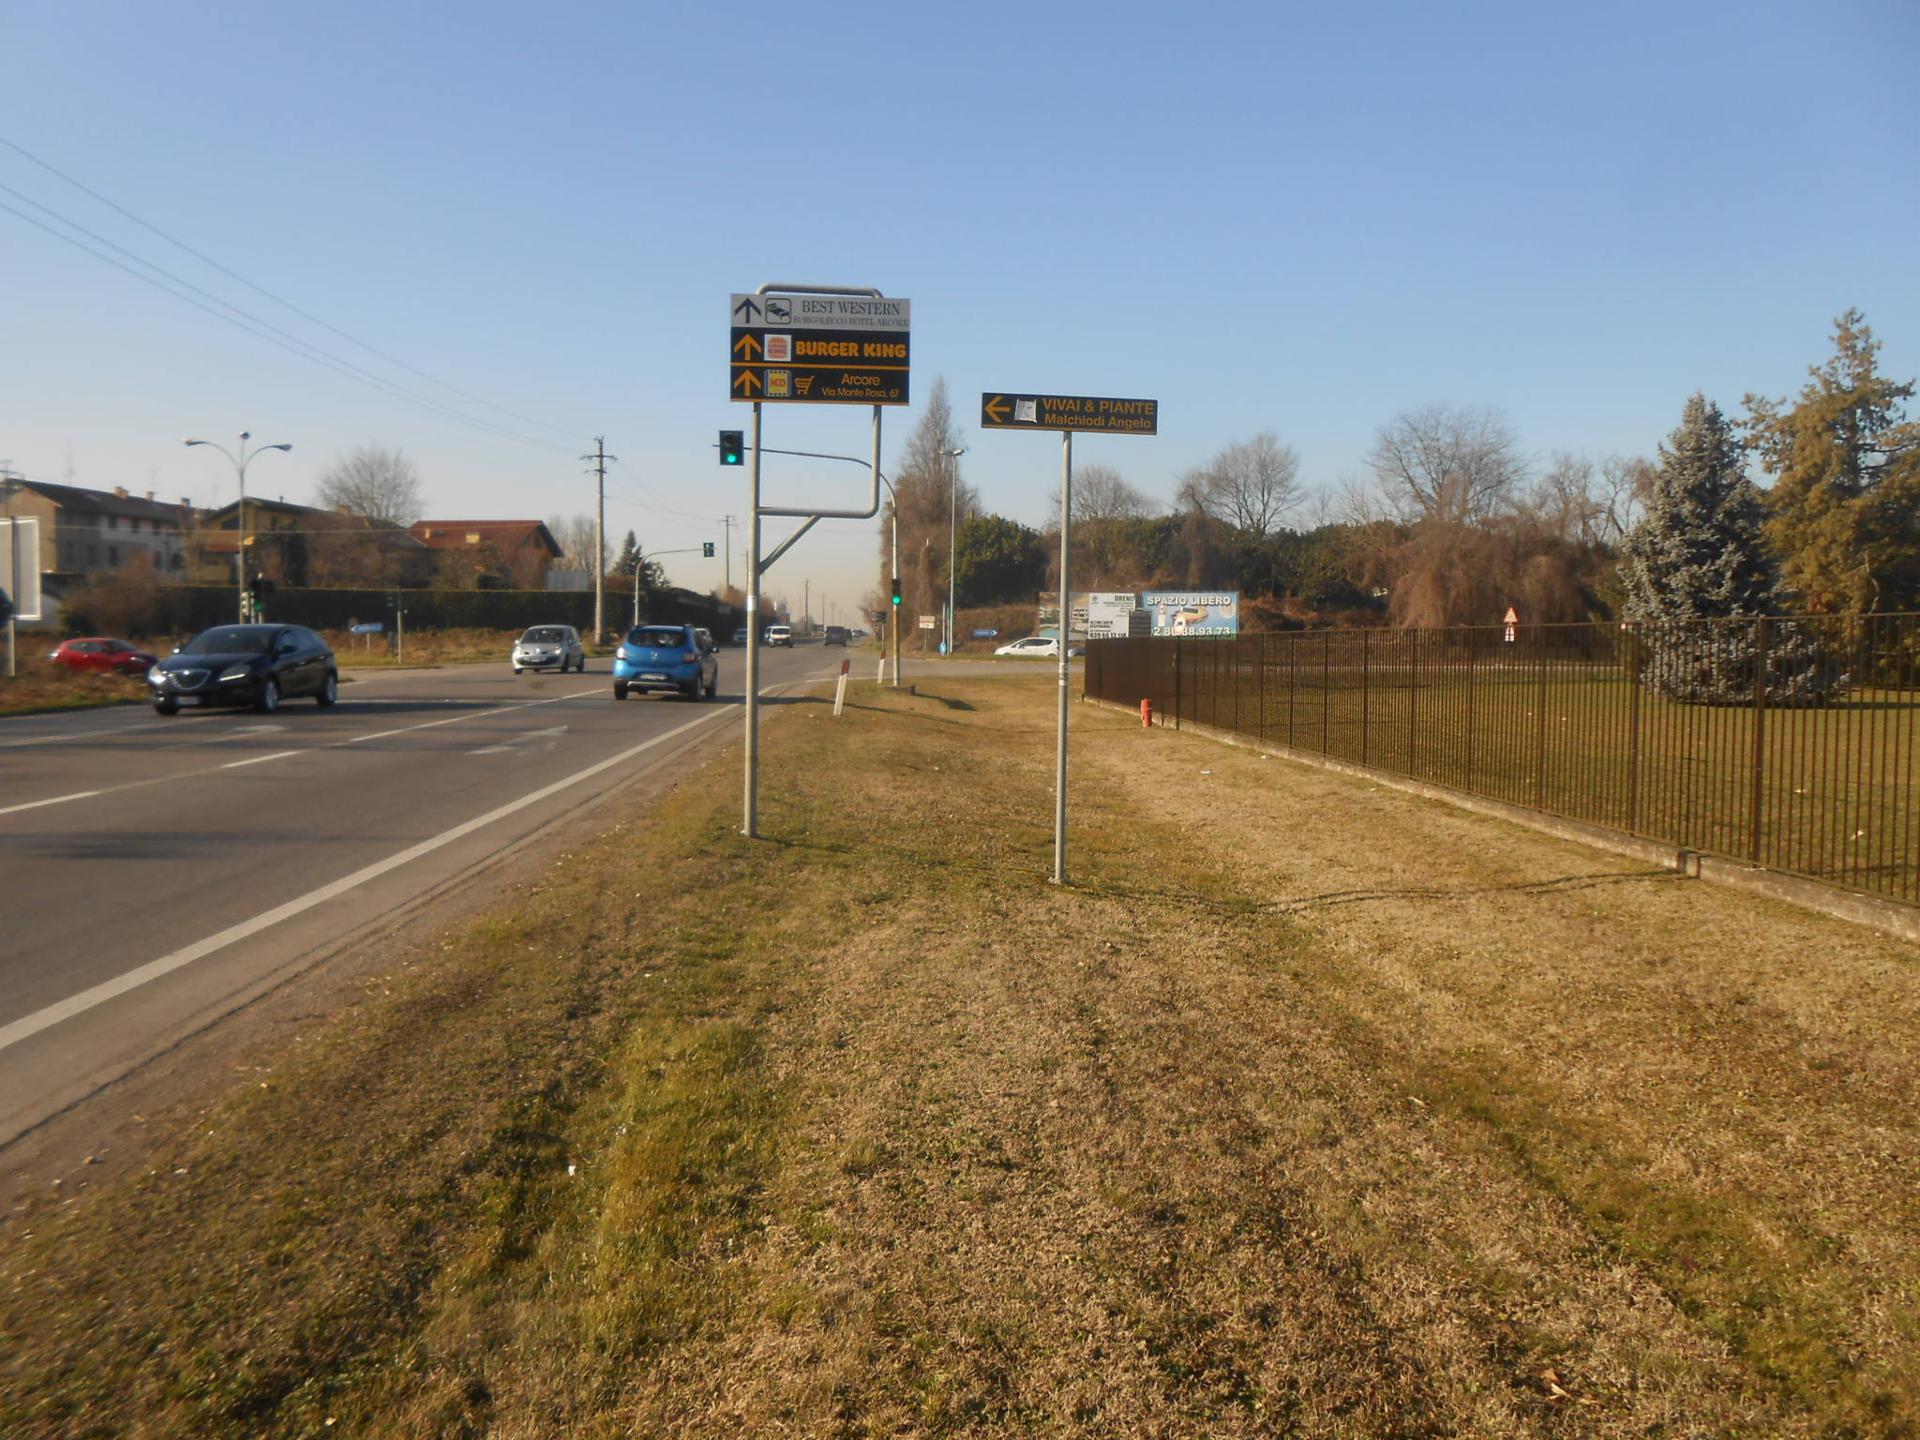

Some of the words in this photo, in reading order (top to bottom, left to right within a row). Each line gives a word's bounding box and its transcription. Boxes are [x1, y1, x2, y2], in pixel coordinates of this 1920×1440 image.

[802, 300, 834, 315] BEST
[836, 301, 900, 316] WESTERN
[849, 318, 875, 327] HOTEL
[796, 341, 859, 357] BURGER
[863, 343, 907, 358] KING
[841, 373, 881, 386] Arcore
[821, 387, 836, 396] Via
[837, 387, 864, 397] Monte
[1042, 398, 1080, 411] VIVAI
[1085, 400, 1095, 411] &
[1100, 400, 1155, 415] PIANTE
[1045, 413, 1105, 426] Malchiodi
[1108, 416, 1152, 430] Angelo
[1147, 595, 1187, 606] SPAZIO
[1190, 596, 1232, 606] LIBERO
